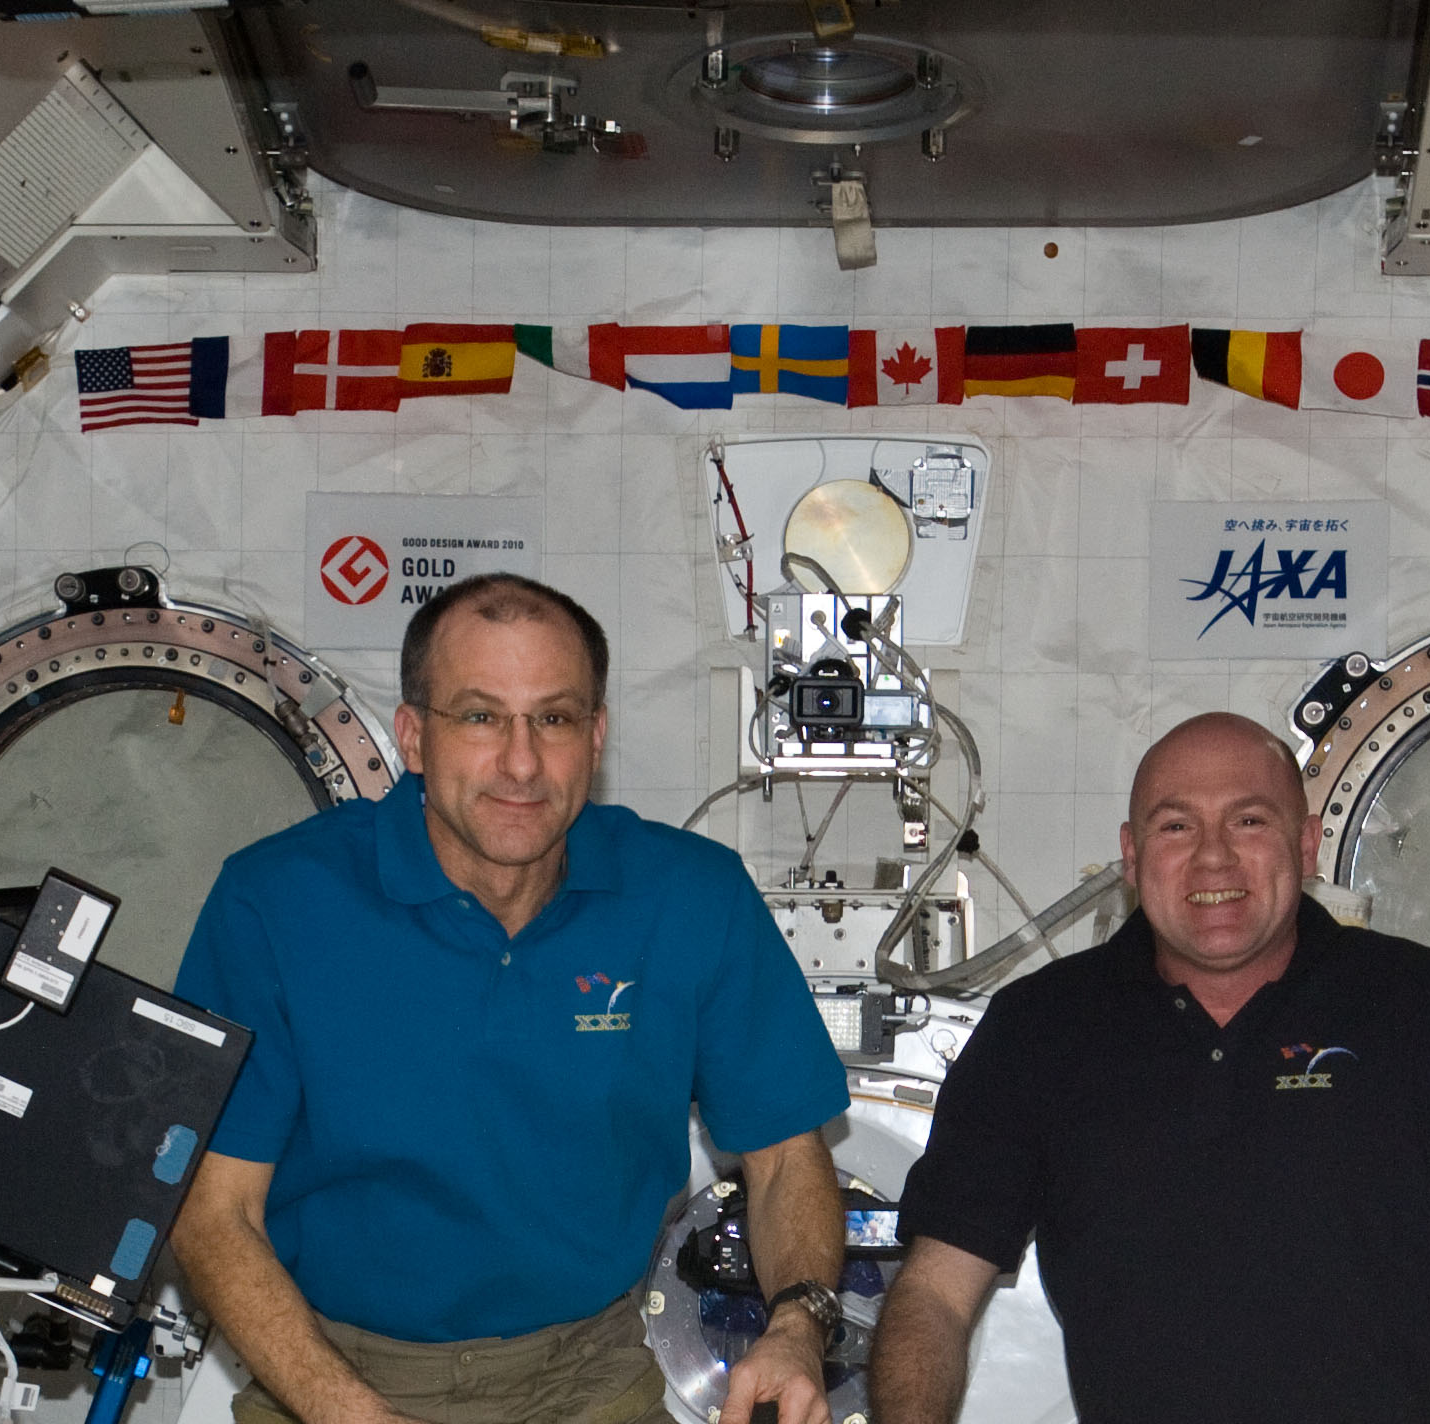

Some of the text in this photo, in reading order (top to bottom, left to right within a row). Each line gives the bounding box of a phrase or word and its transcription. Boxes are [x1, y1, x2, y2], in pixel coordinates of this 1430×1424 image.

[1223, 519, 1349, 532] 空へ挑み、宇宙を拓く
[402, 538, 524, 550] GOOD DESIGN AWARD 2010
[402, 557, 456, 578] GOLD
[175, 1017, 196, 1033] SSC
[574, 1013, 631, 1032] XXX
[1275, 1073, 1332, 1090] XXX
